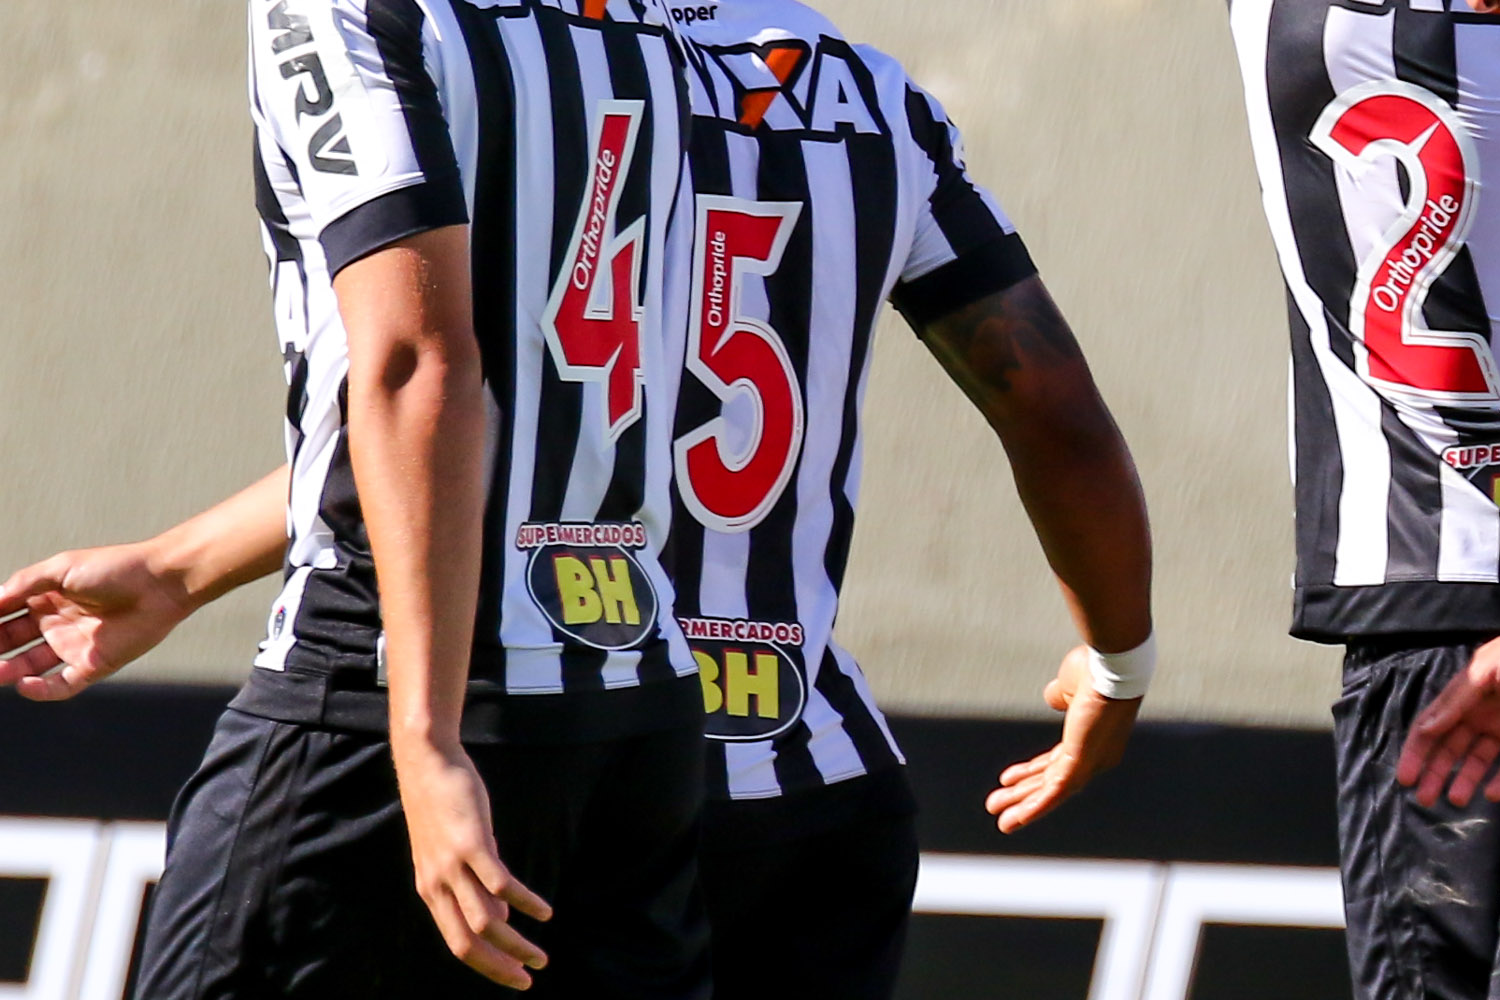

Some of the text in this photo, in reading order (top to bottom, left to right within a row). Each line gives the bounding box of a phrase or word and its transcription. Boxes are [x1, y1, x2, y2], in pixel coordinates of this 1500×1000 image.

[670, 4, 719, 27] pper
[686, 38, 884, 136] IXA
[572, 149, 616, 291] Orthopride
[1371, 193, 1460, 313] Orthopride
[541, 100, 646, 444] 4
[707, 230, 727, 328] Orthopride
[674, 194, 803, 532] 5
[517, 525, 646, 546] SUPEMERCADOS
[552, 553, 641, 626] BH
[679, 619, 802, 644] RMERCADOS
